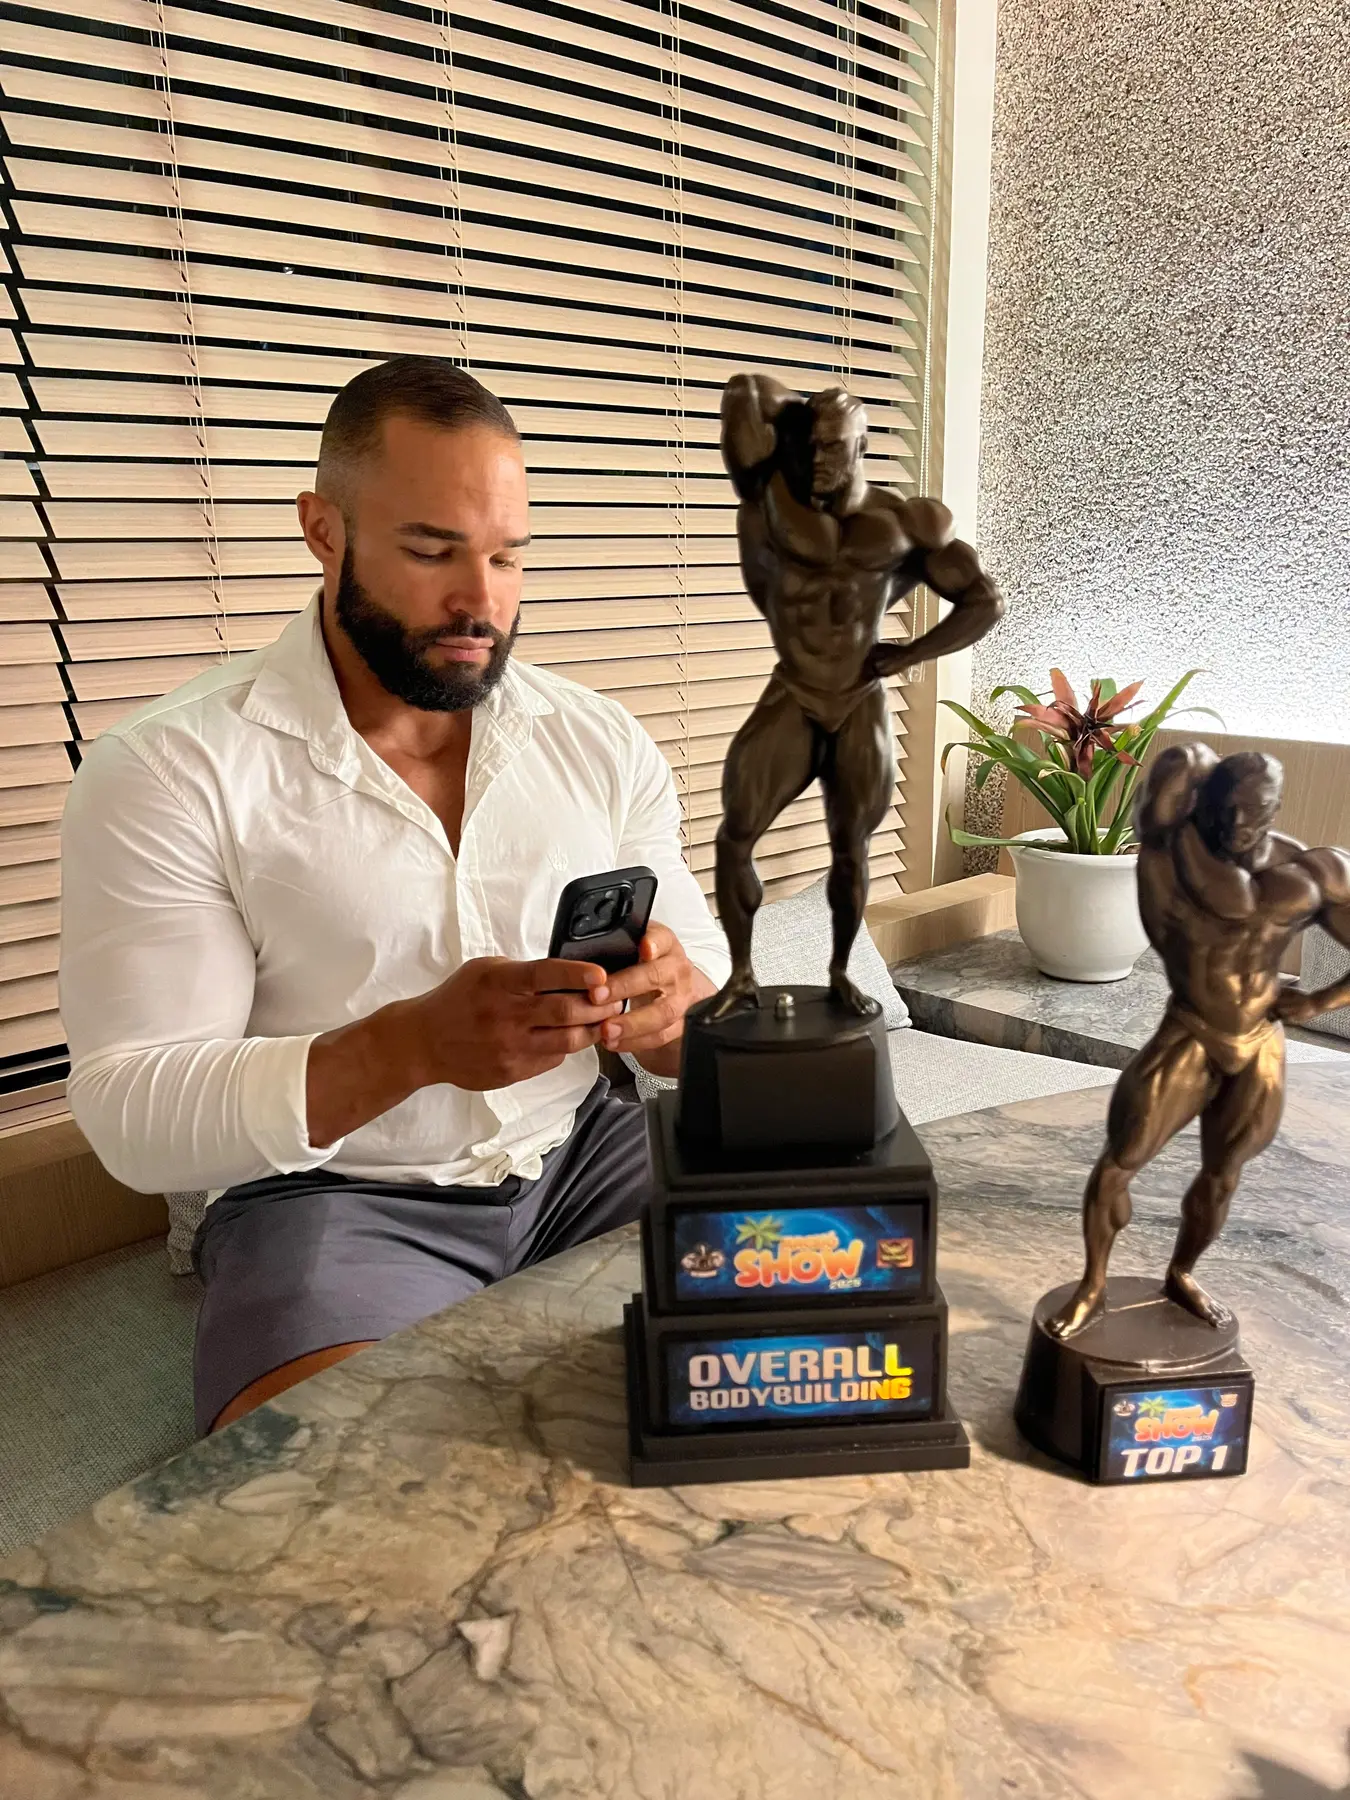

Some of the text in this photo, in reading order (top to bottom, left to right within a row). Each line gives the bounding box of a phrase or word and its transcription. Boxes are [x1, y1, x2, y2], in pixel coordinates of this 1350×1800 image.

[734, 1239, 864, 1288] SHOW
[689, 1343, 913, 1388] OVERALL
[690, 1377, 911, 1411] BODYBUILDING
[1134, 1409, 1219, 1442] SHOW
[1121, 1445, 1228, 1477] TOP 1
